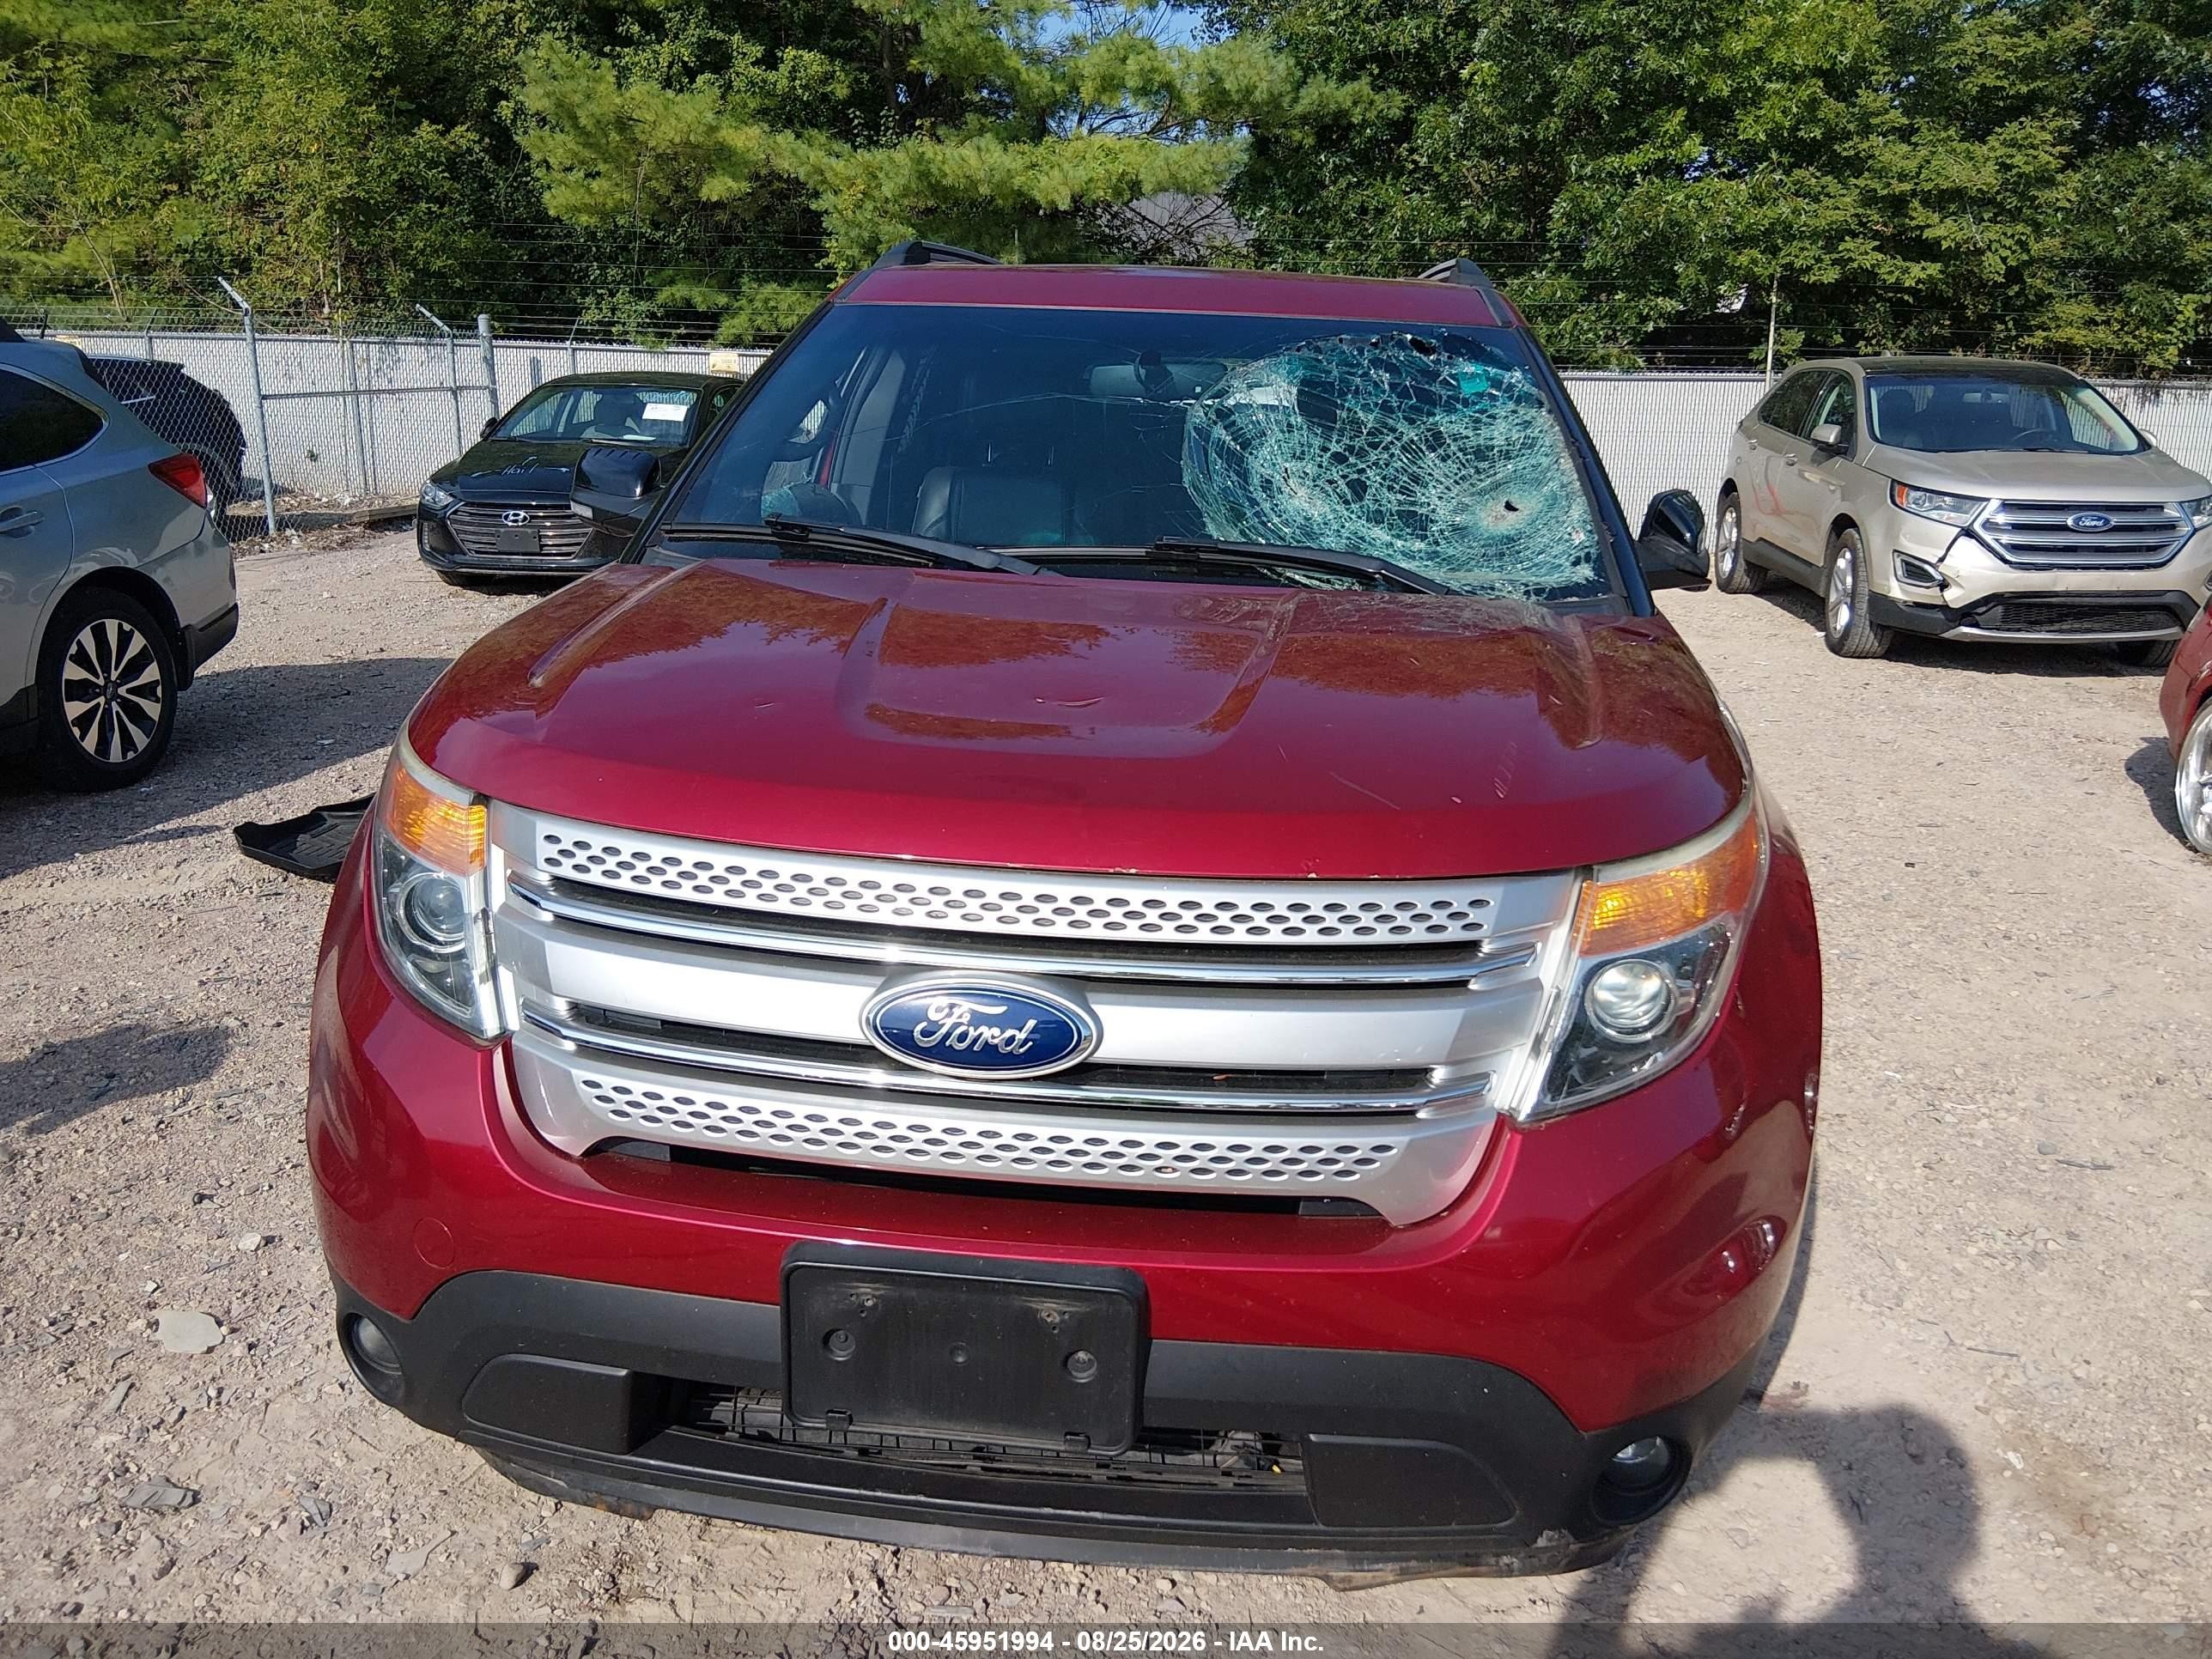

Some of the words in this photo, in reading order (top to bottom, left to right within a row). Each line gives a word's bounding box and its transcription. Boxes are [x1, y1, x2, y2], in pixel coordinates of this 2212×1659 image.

[501, 463, 540, 476] Hail
[2078, 515, 2105, 526] Ford
[913, 999, 1038, 1054] Ford
